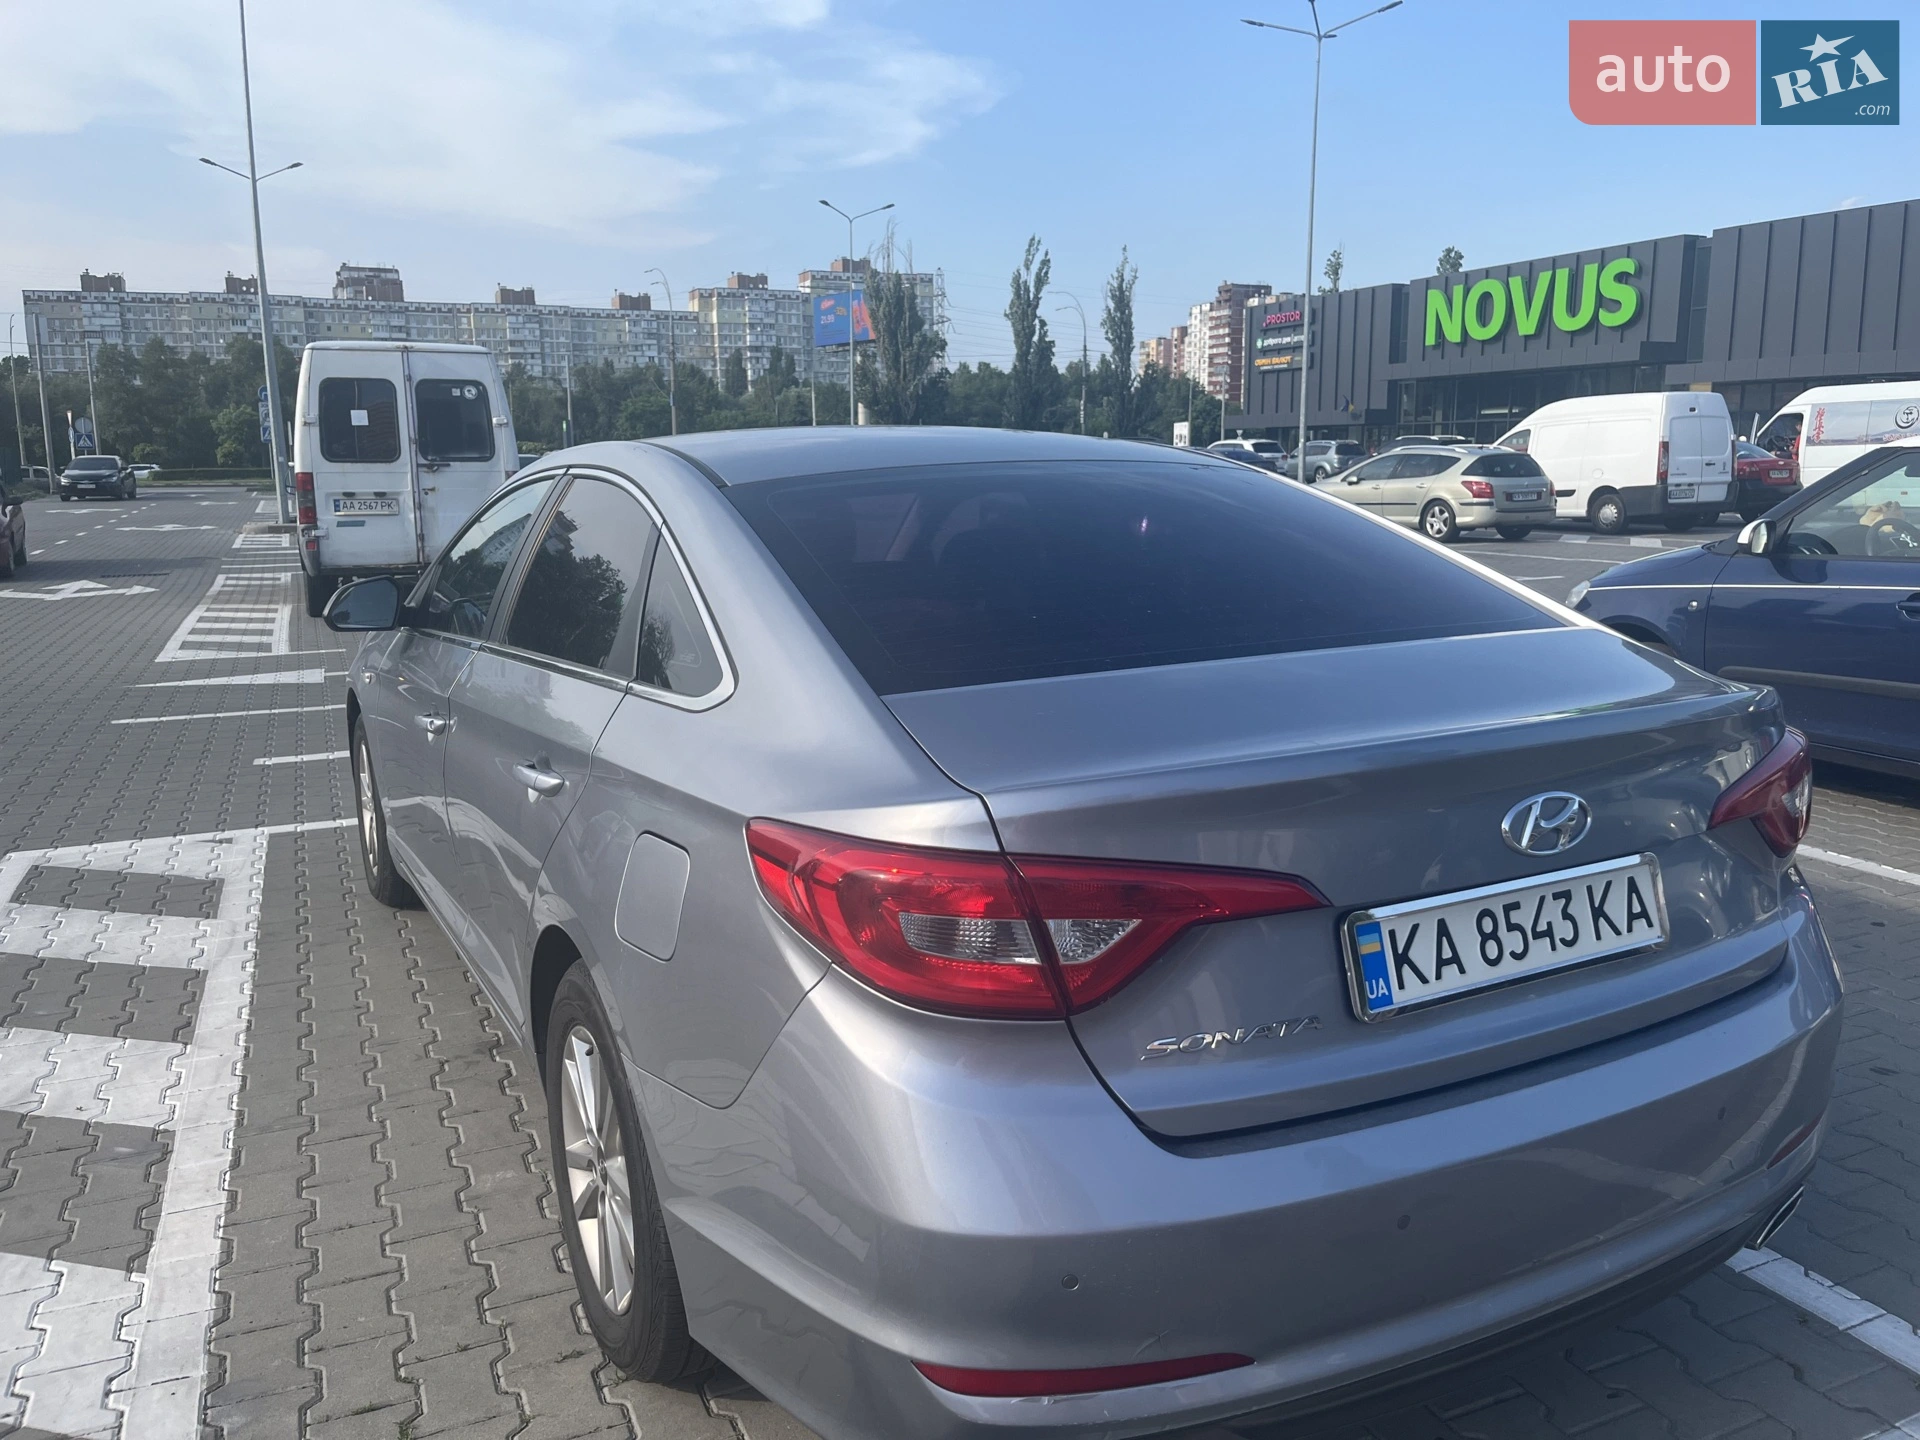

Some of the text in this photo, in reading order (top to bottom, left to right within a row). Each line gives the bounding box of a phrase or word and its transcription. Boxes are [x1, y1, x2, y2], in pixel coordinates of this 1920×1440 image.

[1425, 257, 1641, 346] NOVUS
[342, 501, 394, 511] AA 2567 PK
[1388, 875, 1654, 991] KA 8543 KA
[1365, 976, 1390, 1000] UA
[1140, 1014, 1324, 1062] SONATA
